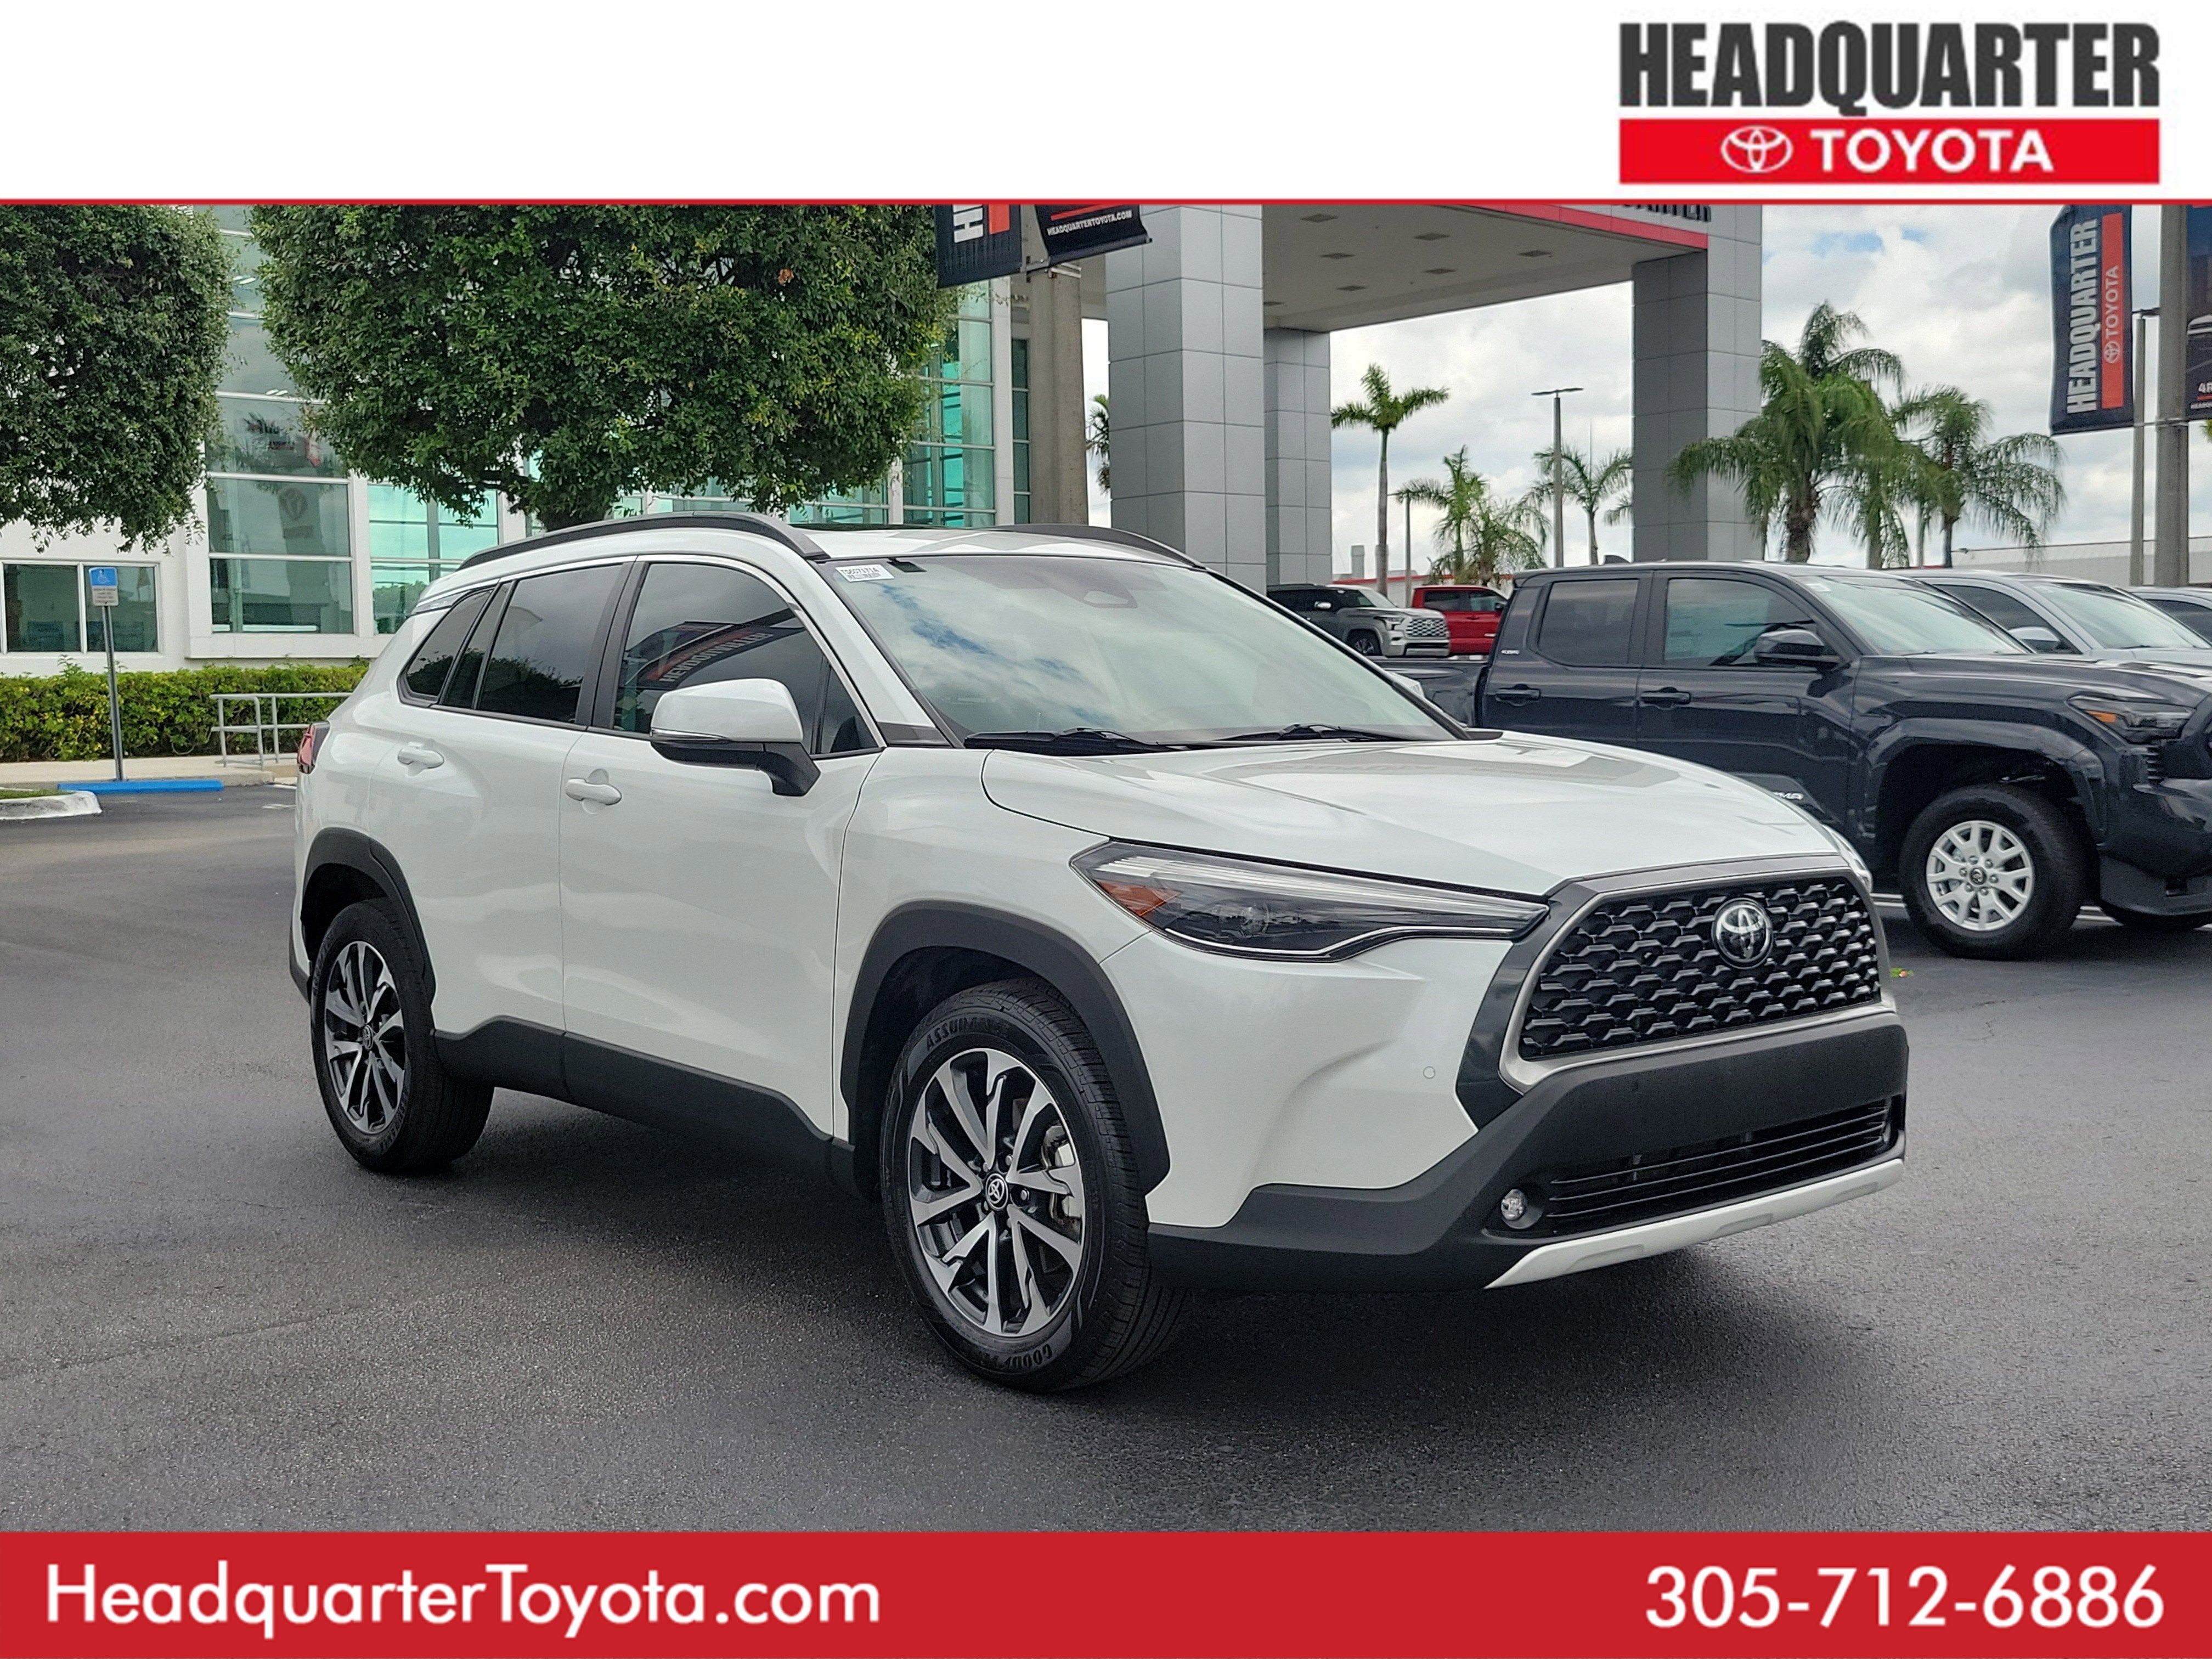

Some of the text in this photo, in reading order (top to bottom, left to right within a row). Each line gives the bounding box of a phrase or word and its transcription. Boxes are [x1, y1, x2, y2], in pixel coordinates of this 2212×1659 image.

[1047, 210, 1132, 236] HEADQUARTERTOYOTA.COM
[2067, 218, 2101, 414] HEADQUARTER
[2104, 266, 2120, 339] TOYOTA
